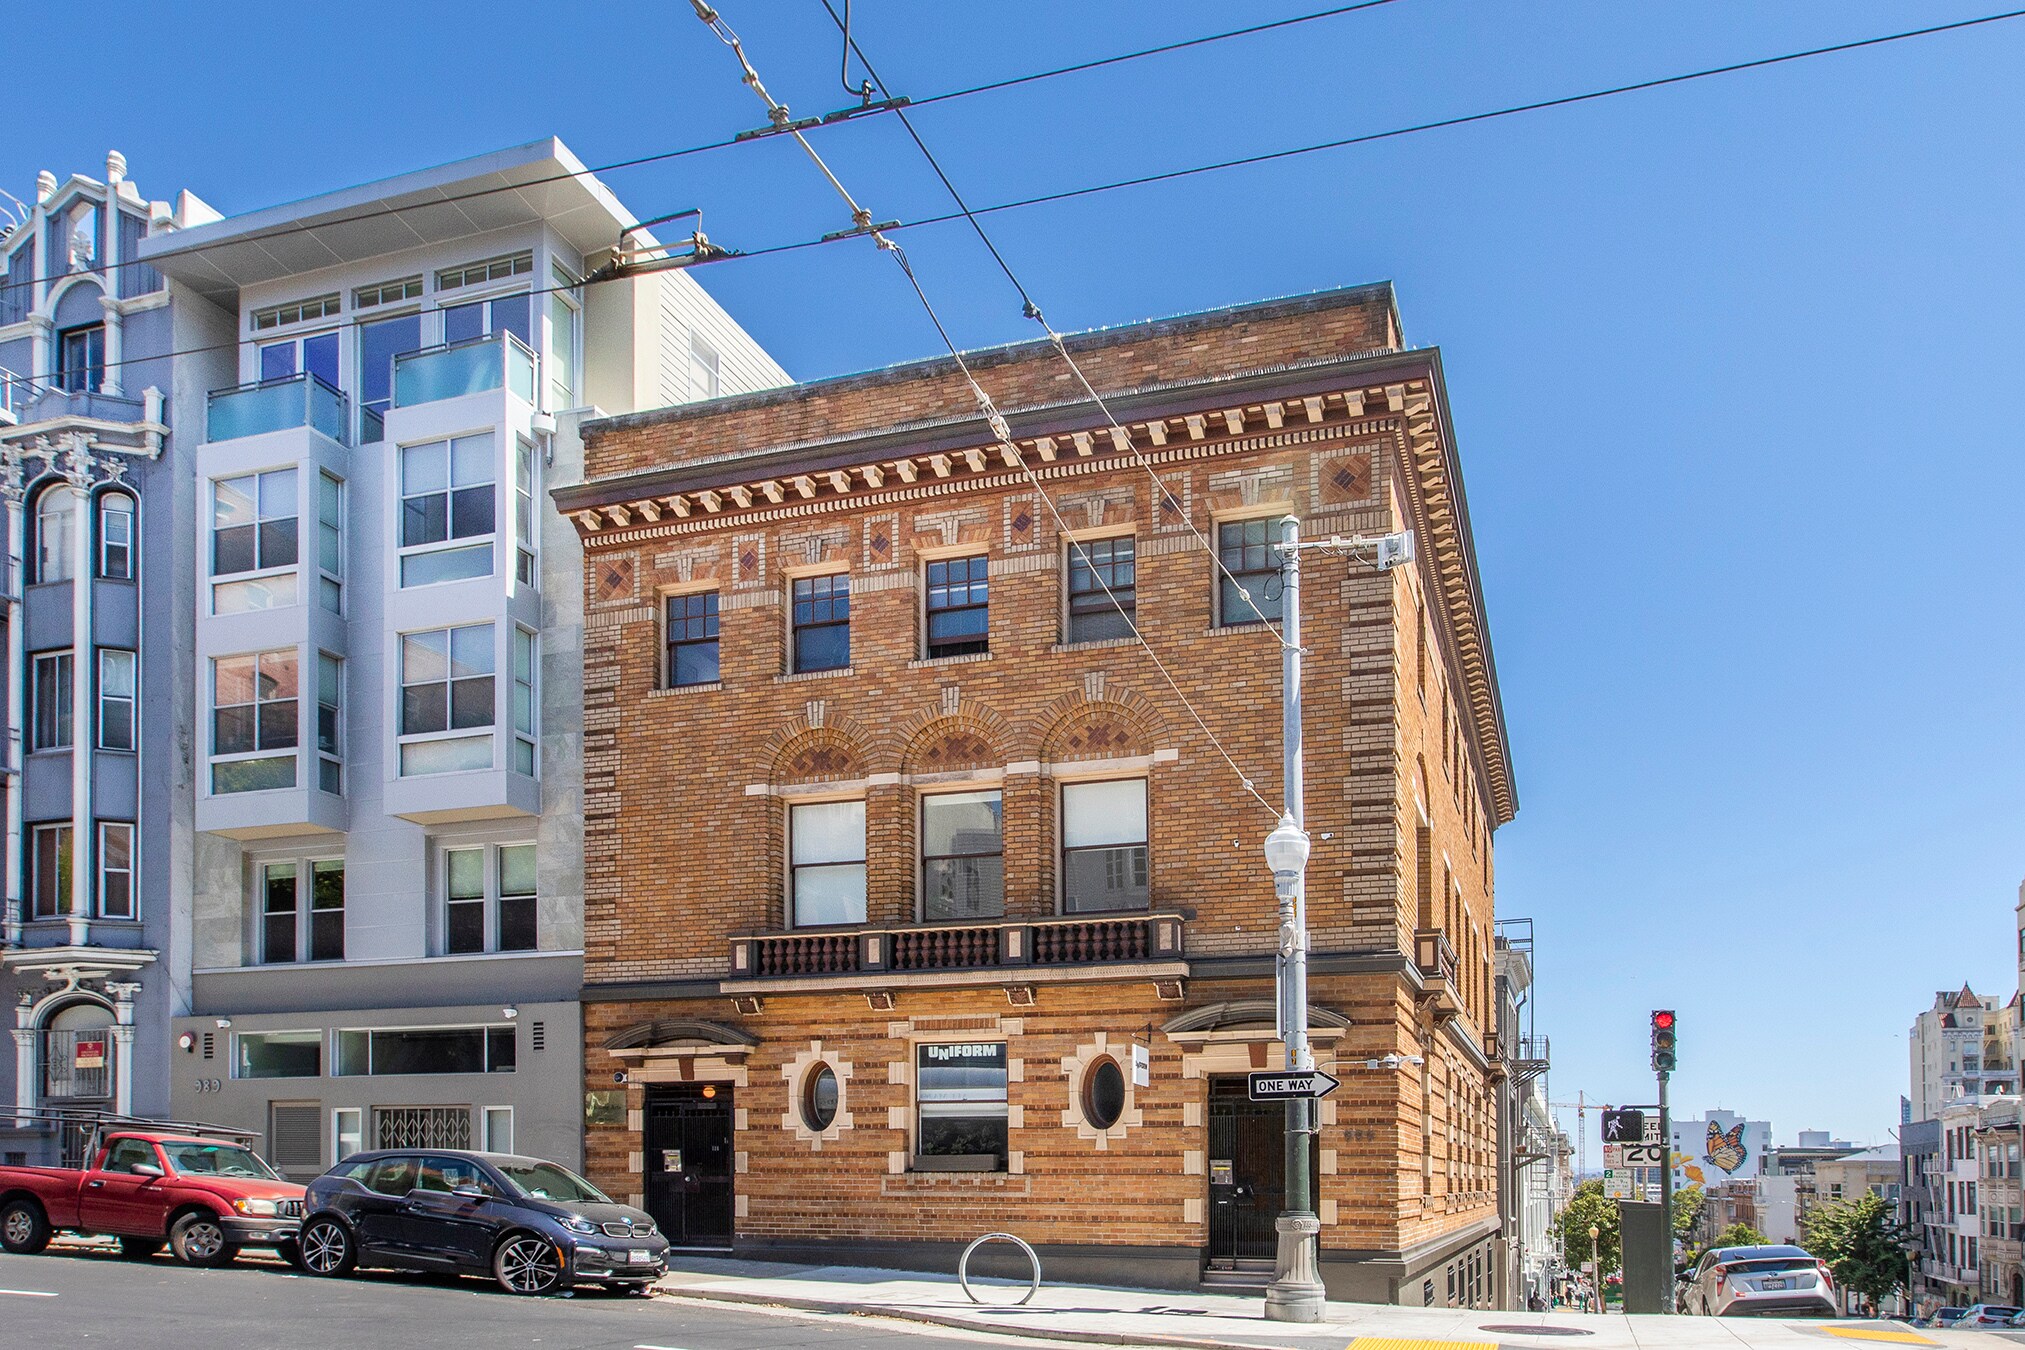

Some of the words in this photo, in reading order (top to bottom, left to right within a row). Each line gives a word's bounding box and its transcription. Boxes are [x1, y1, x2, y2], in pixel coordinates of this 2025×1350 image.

[928, 1045, 997, 1061] UNIFORM
[194, 1079, 221, 1093] 989
[1259, 1081, 1284, 1091] ONE
[1288, 1080, 1313, 1090] WAY
[1627, 1147, 1661, 1161] 20
